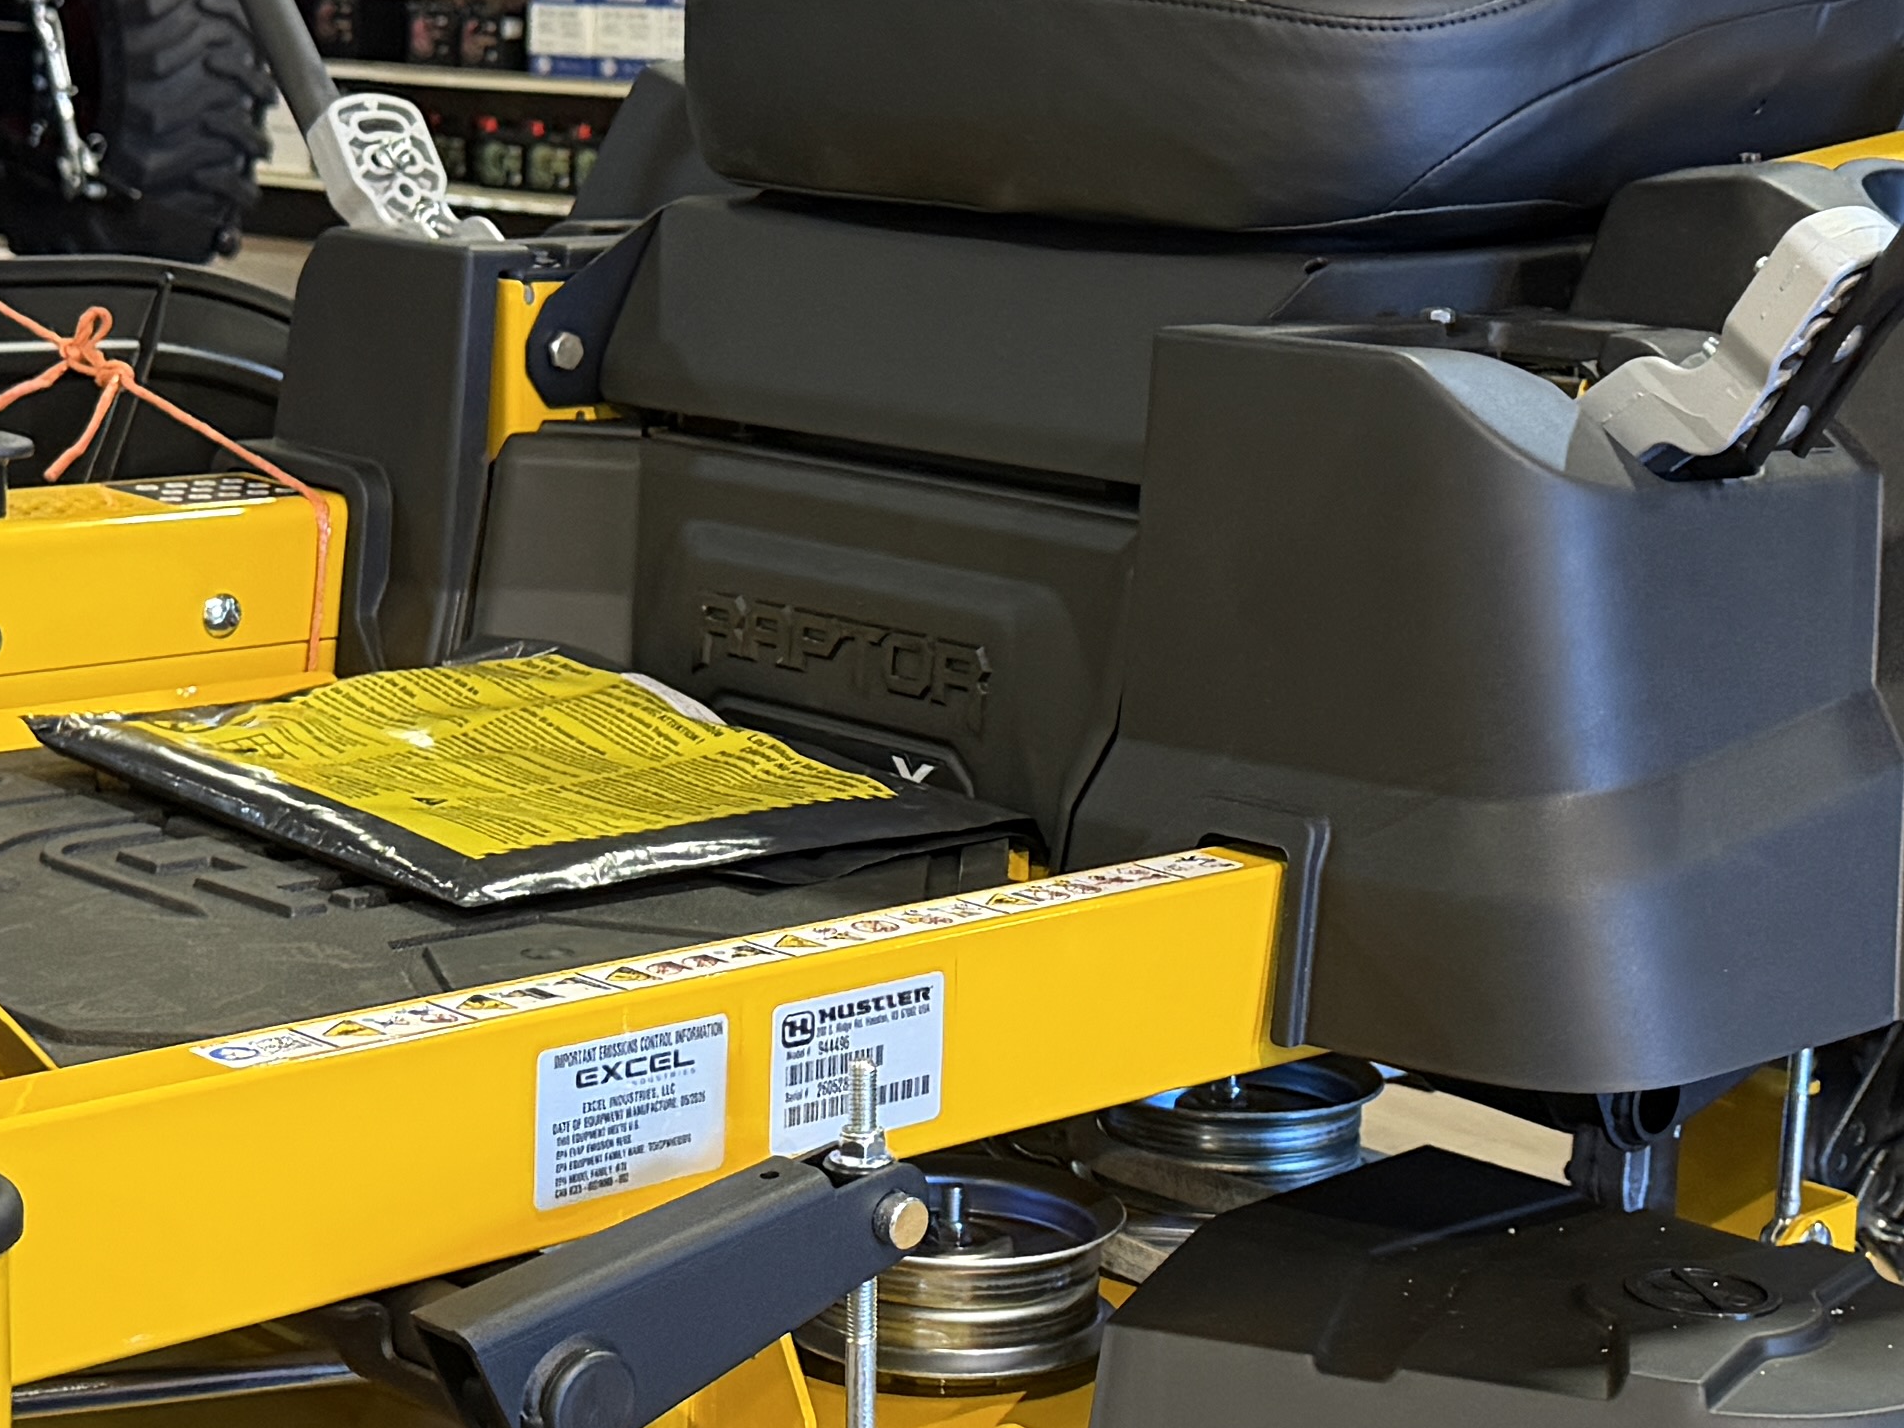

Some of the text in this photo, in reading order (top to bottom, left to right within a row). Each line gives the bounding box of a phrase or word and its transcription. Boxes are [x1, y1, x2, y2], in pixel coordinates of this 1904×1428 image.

[693, 590, 992, 737] RAPTOR
[818, 985, 930, 1024] HUSTLER
[554, 1020, 723, 1070] IMPORTANT EMISSIONS CONTROL INFORMATION
[575, 1049, 695, 1089] EXCEL
[582, 1097, 606, 1114] EXCEL
[661, 1082, 675, 1096] LLC
[552, 1120, 570, 1135] DATE
[572, 1118, 581, 1131] OF
[583, 1108, 623, 1128] EQUIPMENT
